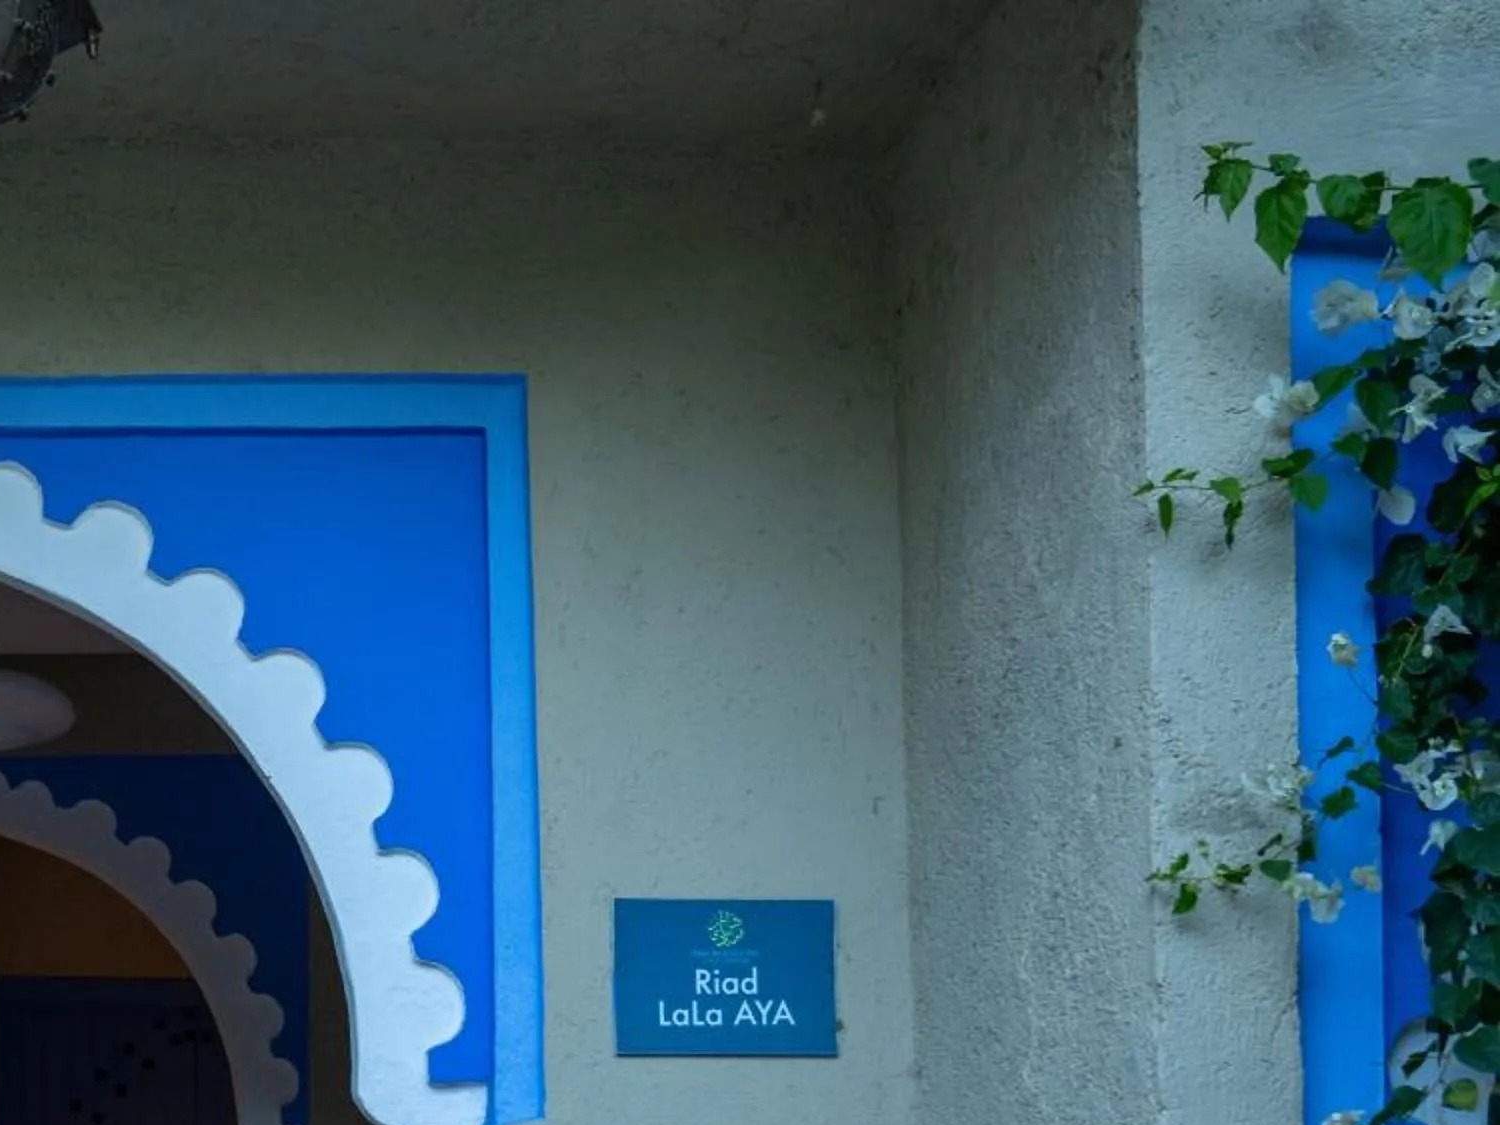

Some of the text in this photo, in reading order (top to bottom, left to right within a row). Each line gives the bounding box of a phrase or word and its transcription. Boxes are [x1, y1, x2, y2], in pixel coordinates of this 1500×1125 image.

[695, 967, 757, 995] Riad
[659, 1000, 796, 1026] LaLa AYA
